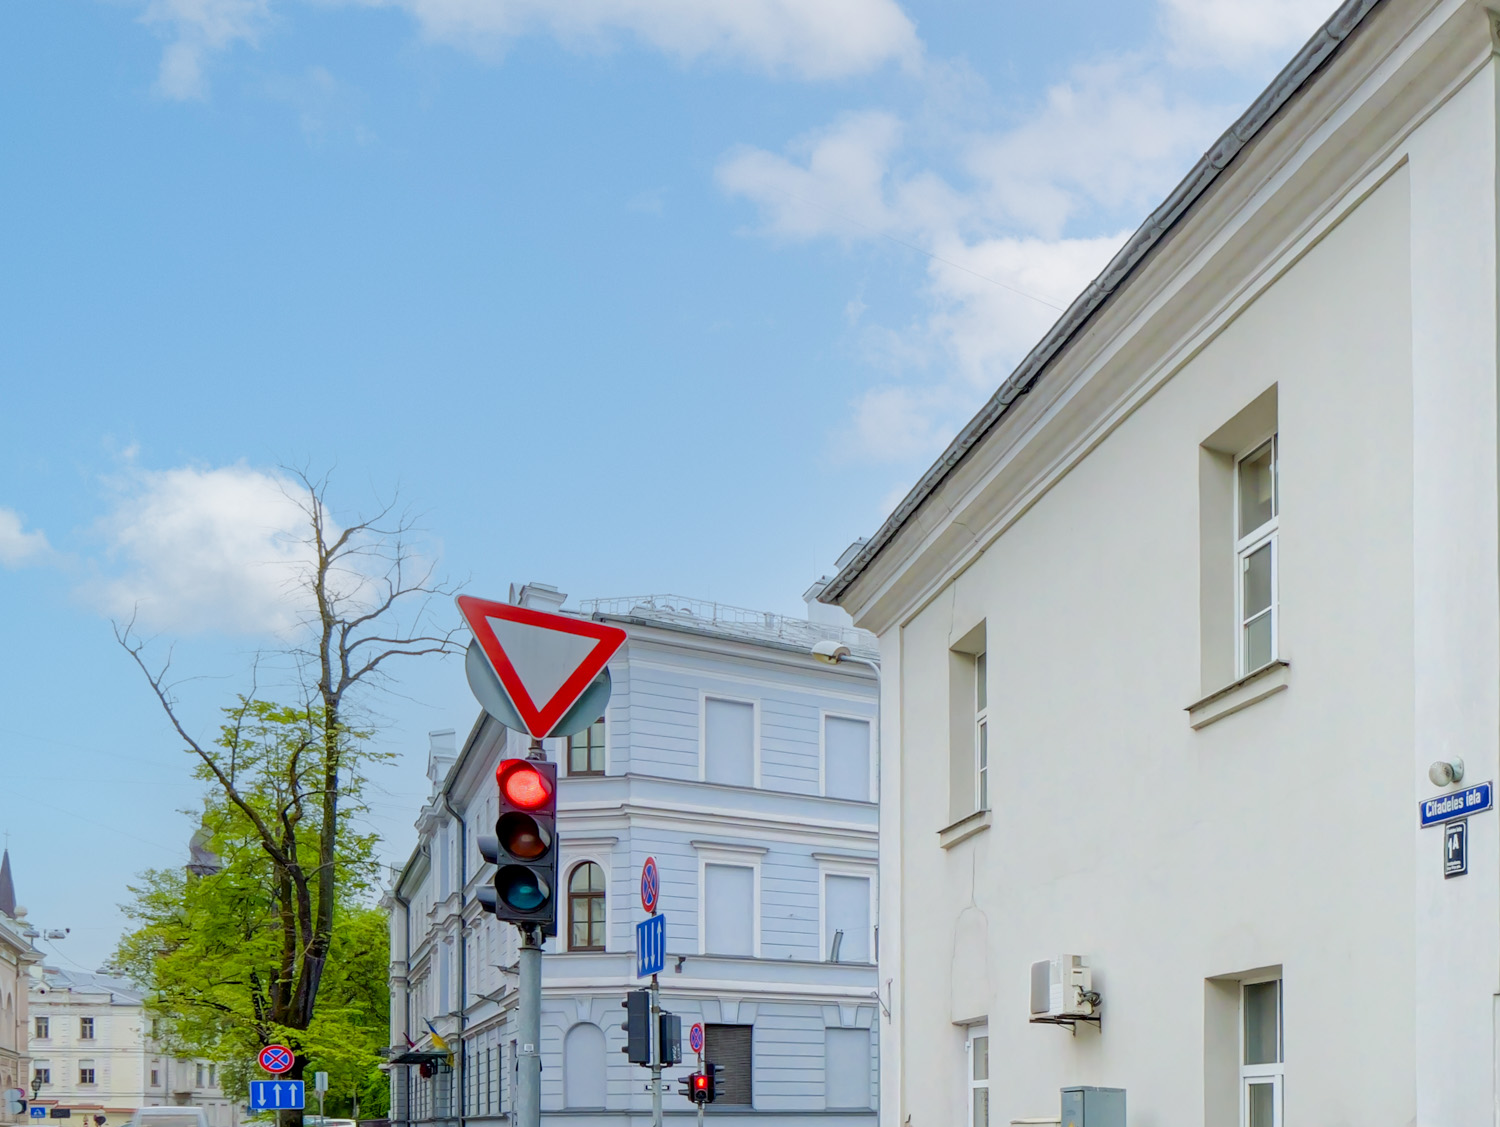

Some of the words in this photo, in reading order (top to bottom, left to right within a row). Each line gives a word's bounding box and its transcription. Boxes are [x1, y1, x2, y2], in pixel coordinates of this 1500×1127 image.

[1426, 796, 1463, 817] Citadeles
[1466, 789, 1481, 807] iela
[1448, 833, 1459, 859] 1A
